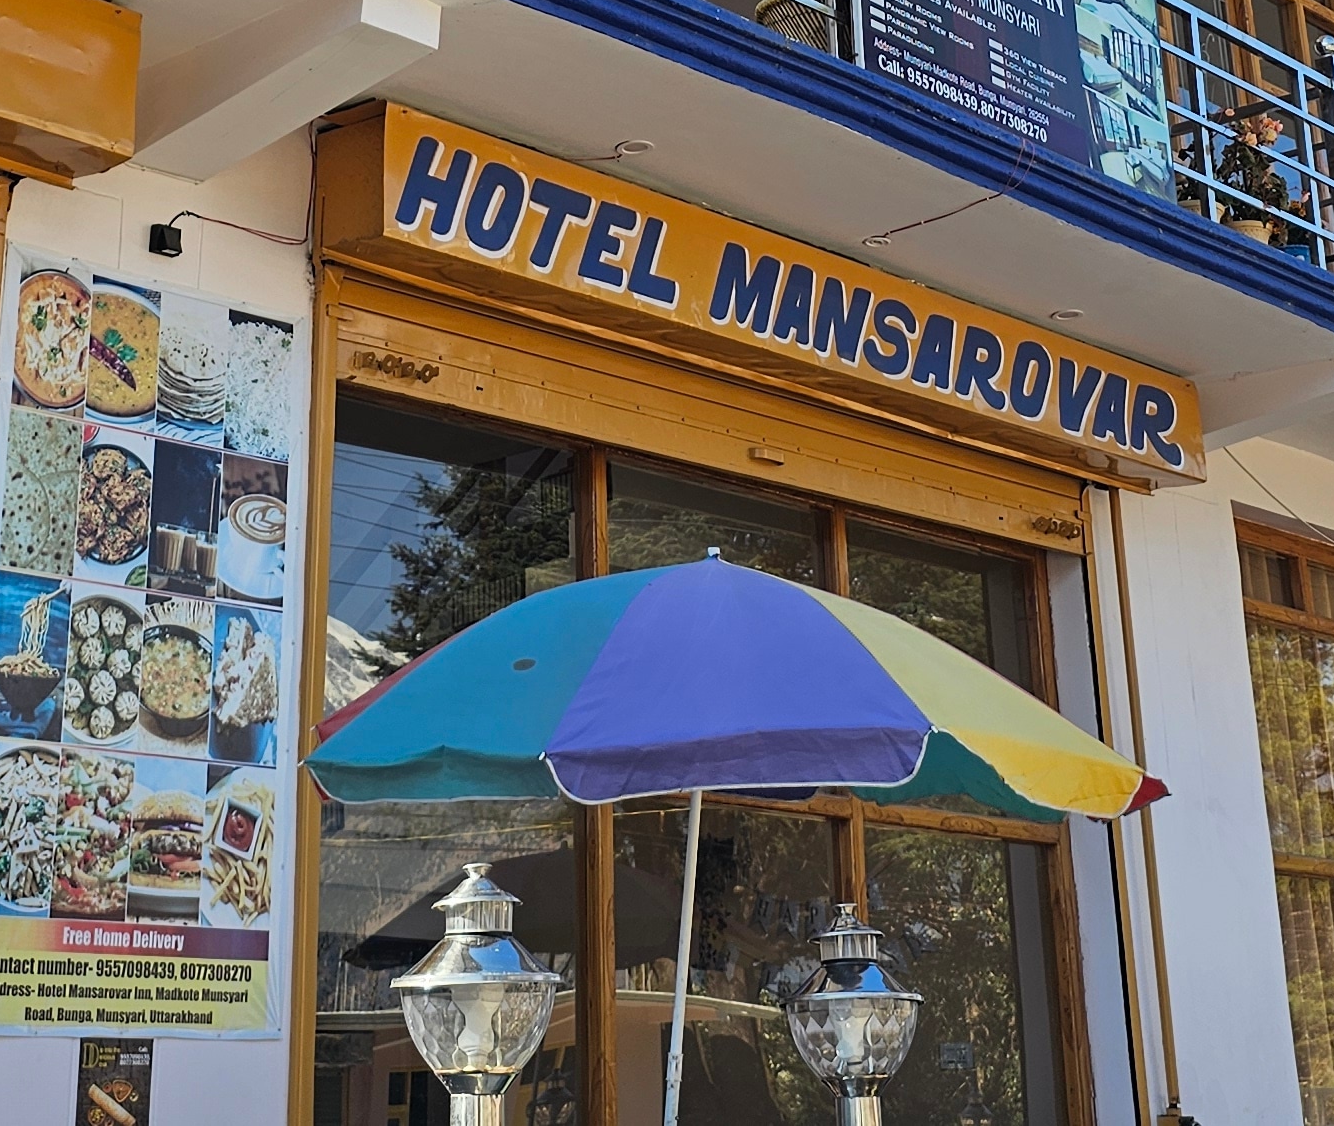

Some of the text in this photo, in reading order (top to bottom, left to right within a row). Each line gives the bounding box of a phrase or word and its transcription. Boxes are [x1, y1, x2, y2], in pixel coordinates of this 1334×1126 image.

[878, 54, 904, 78] Call:
[395, 134, 1188, 472] HOTEL MANSAROVAR
[63, 927, 184, 951] Free Home Delivery
[37, 958, 93, 976] number-
[96, 959, 178, 981] 9557098439,
[180, 962, 252, 982] 8077308270
[38, 983, 67, 998] Hotel
[69, 984, 132, 1000] Mansarovar
[134, 986, 153, 1001] Inn,
[155, 987, 199, 1001] Madkote
[202, 989, 248, 1003] Munsyari
[25, 1007, 213, 1024] Road, Bunga, Munsyari, Uttarakhand
